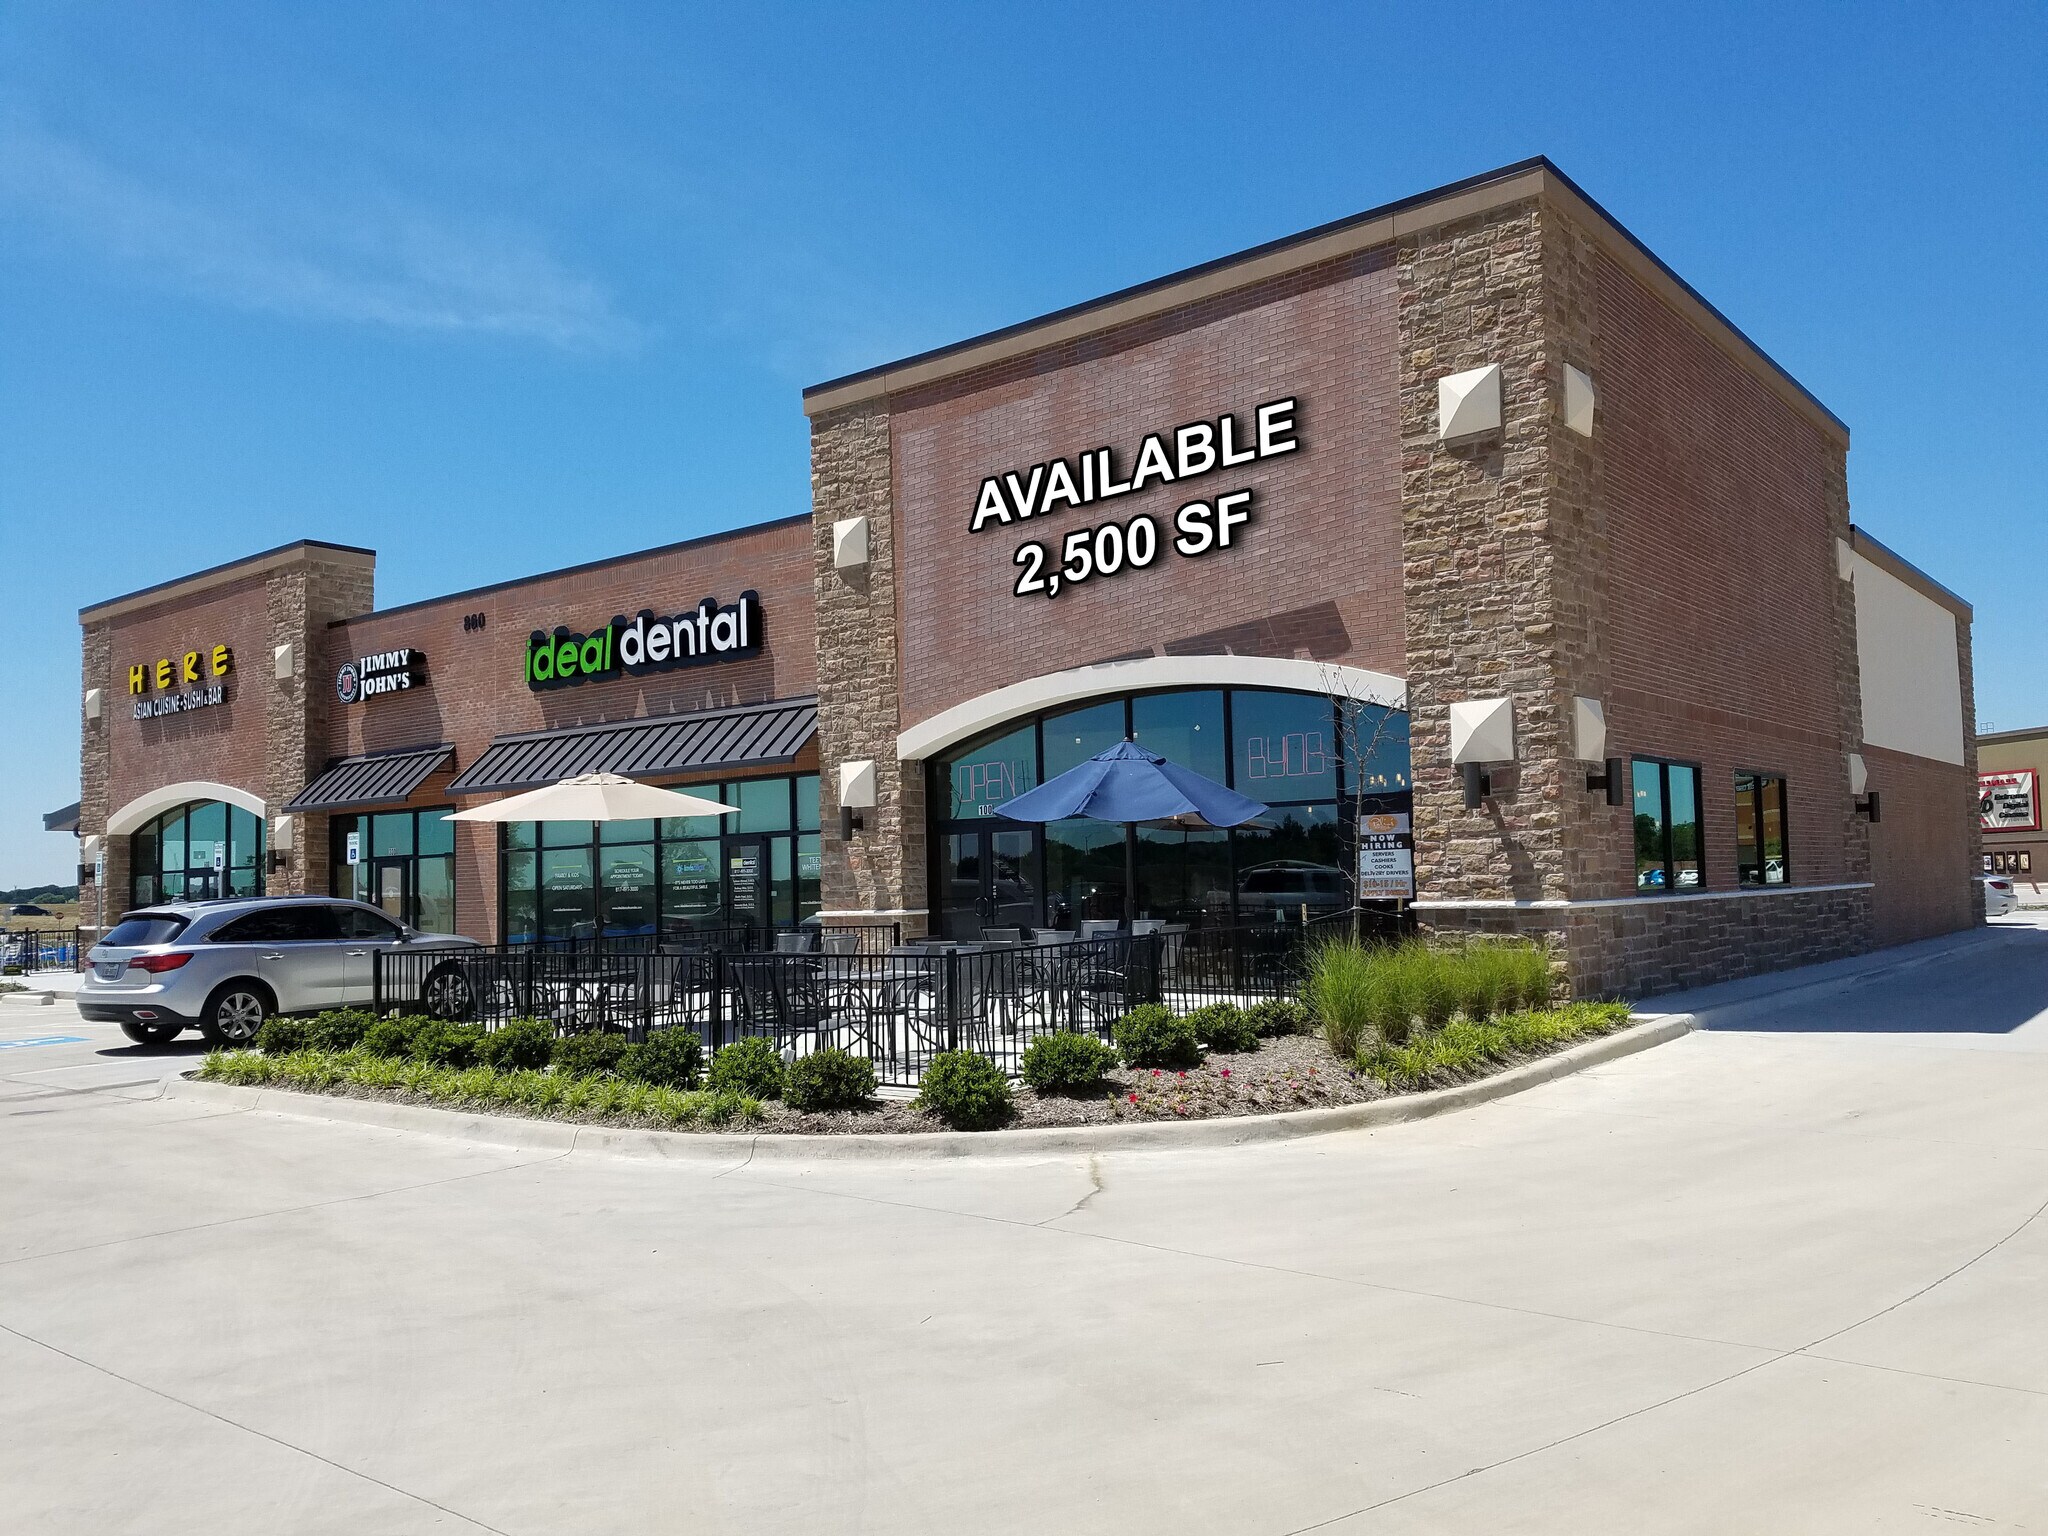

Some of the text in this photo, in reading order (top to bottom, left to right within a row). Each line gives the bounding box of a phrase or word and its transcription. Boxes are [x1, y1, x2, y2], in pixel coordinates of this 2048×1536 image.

[525, 598, 748, 682] ideal dental
[129, 645, 228, 695] HERE
[360, 649, 409, 679] JIMMY
[133, 701, 152, 720] ASIAN
[208, 686, 222, 706] BAR
[360, 672, 410, 701] JOHN'S
[1248, 732, 1325, 778] BYOB
[959, 761, 1016, 803] OPEN
[1361, 841, 1403, 850] HIRING
[1370, 834, 1395, 842] NOW
